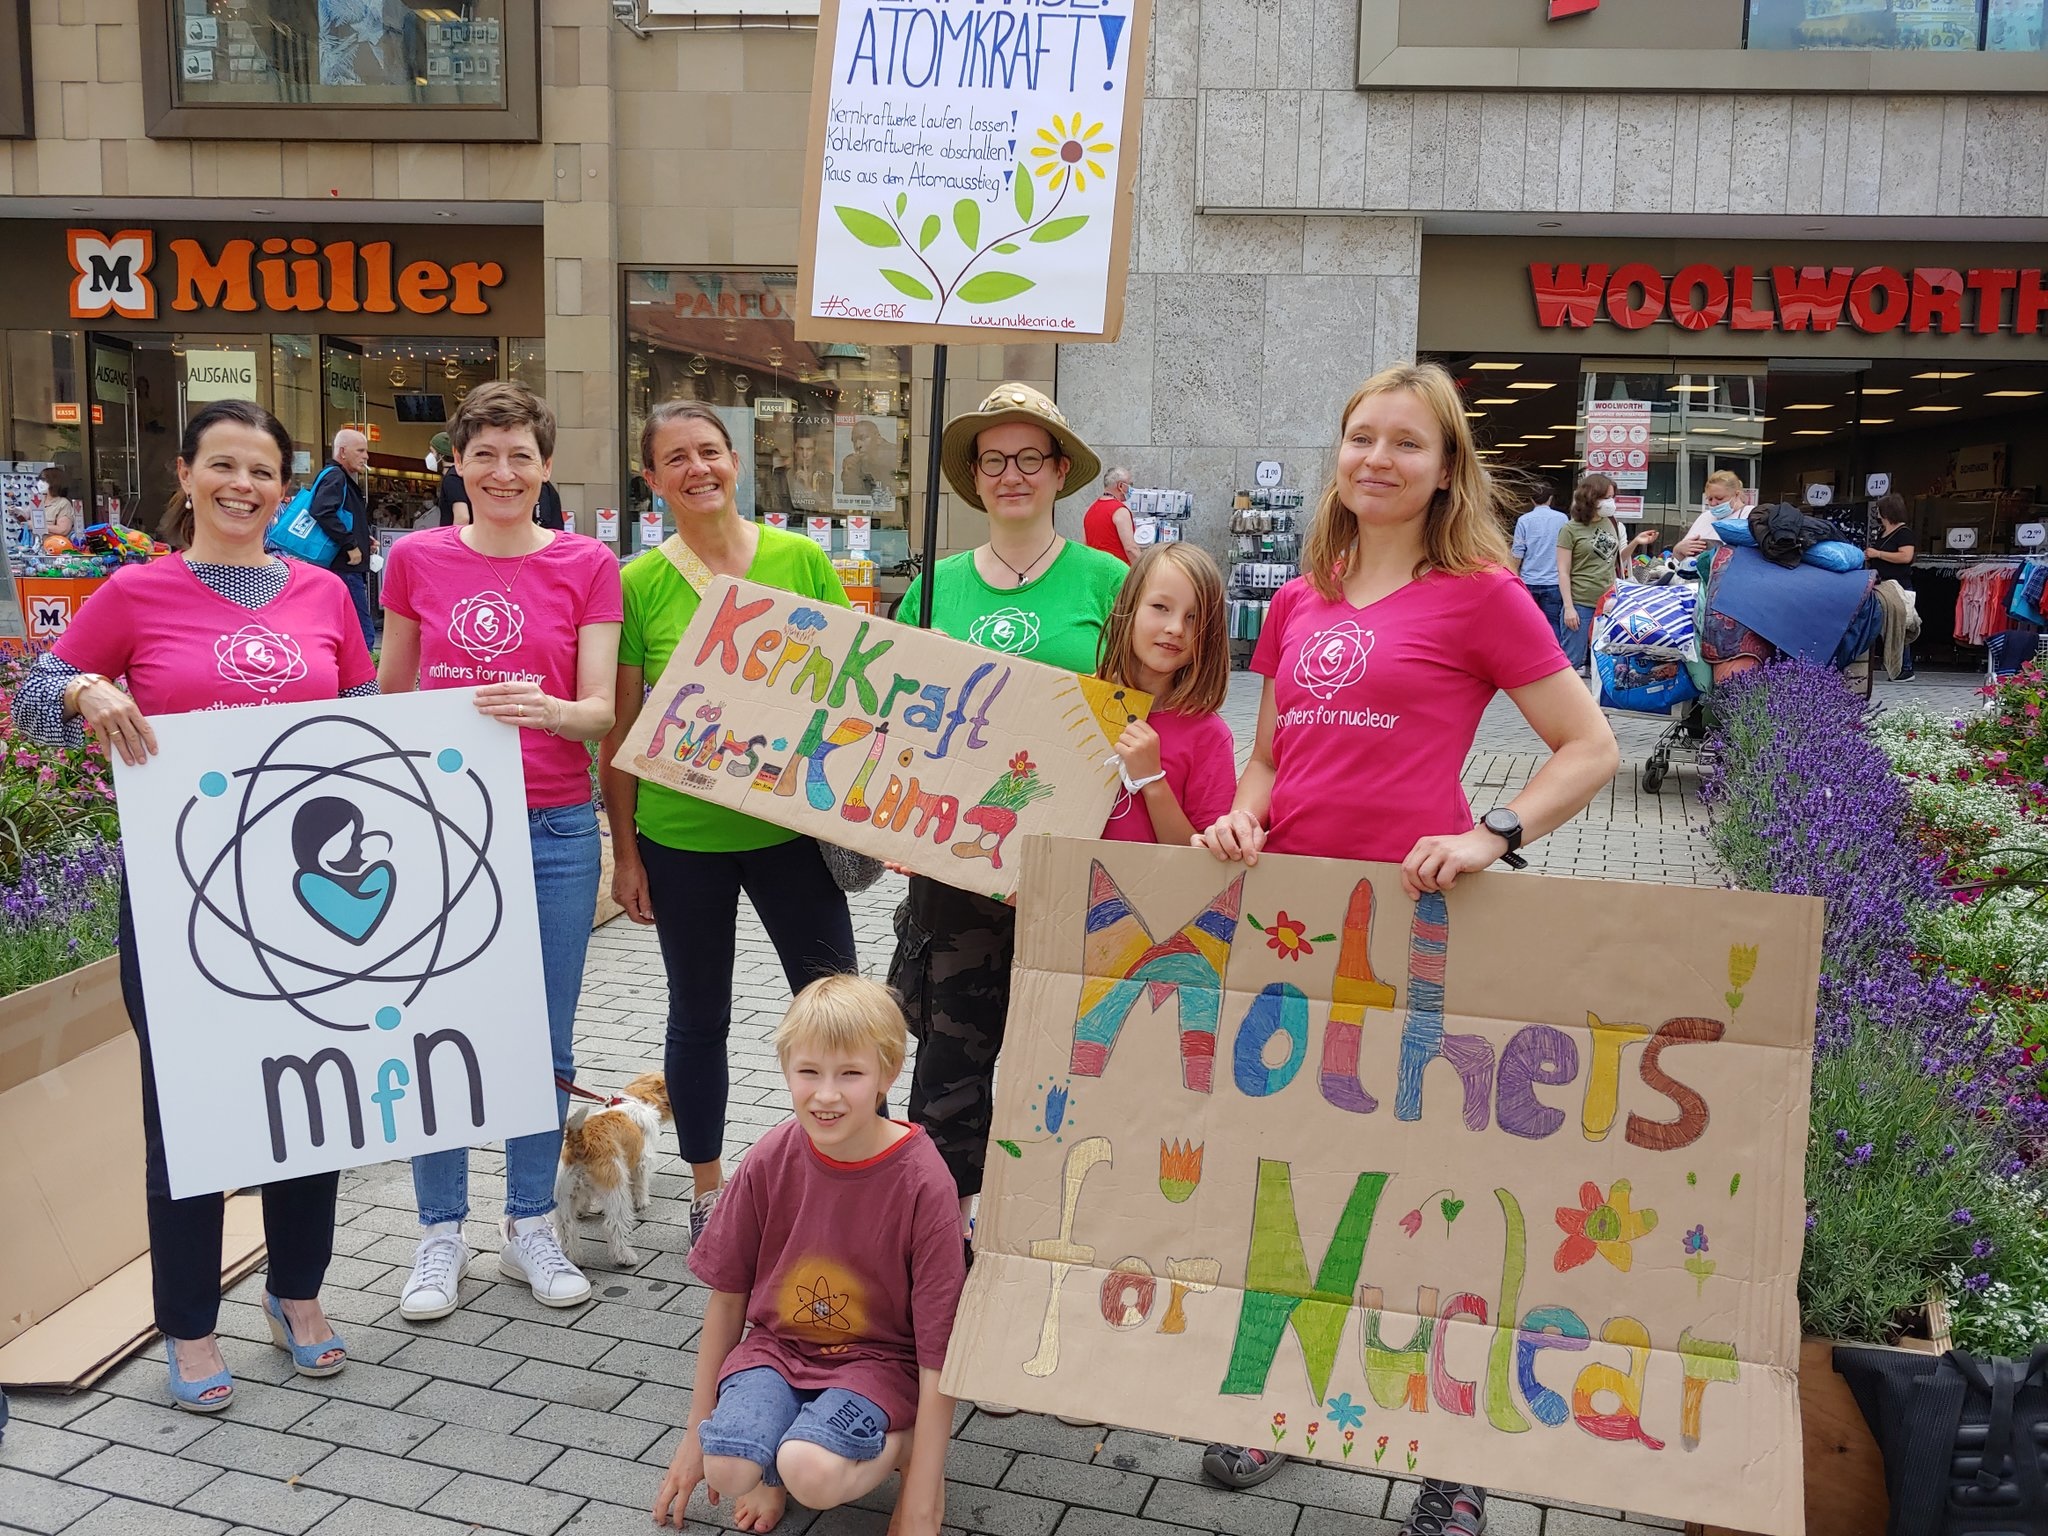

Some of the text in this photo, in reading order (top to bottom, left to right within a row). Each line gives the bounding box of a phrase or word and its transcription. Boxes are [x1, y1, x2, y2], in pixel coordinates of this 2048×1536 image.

[848, 7, 1126, 92] ATOMKRAFT!
[829, 98, 918, 127] Kernkraftwerke
[921, 103, 962, 130] laufen
[827, 126, 1017, 162] Kohlekraftwerke abschalten!
[824, 155, 1014, 203] Raus aus dem Atomausstieg!
[88, 255, 133, 292] M
[170, 237, 503, 315] Müller
[1529, 262, 2048, 334] WOOLWORTH
[96, 366, 128, 387] AUSGANG
[188, 367, 251, 384] AUSGANG
[761, 404, 783, 412] KASSE
[780, 415, 830, 425] AZZARO
[836, 415, 856, 424] DIESEL
[1595, 402, 1643, 410] WOOLWORTH
[39, 609, 60, 626] M
[1637, 622, 1659, 639] ALDI
[428, 661, 474, 680] mothers
[476, 665, 498, 682] for
[1276, 705, 1400, 730] mothers for nuclear
[1068, 857, 1727, 1152] Mothers
[261, 1028, 485, 1164] mfn
[1021, 1136, 1741, 1454] for Nuclear
